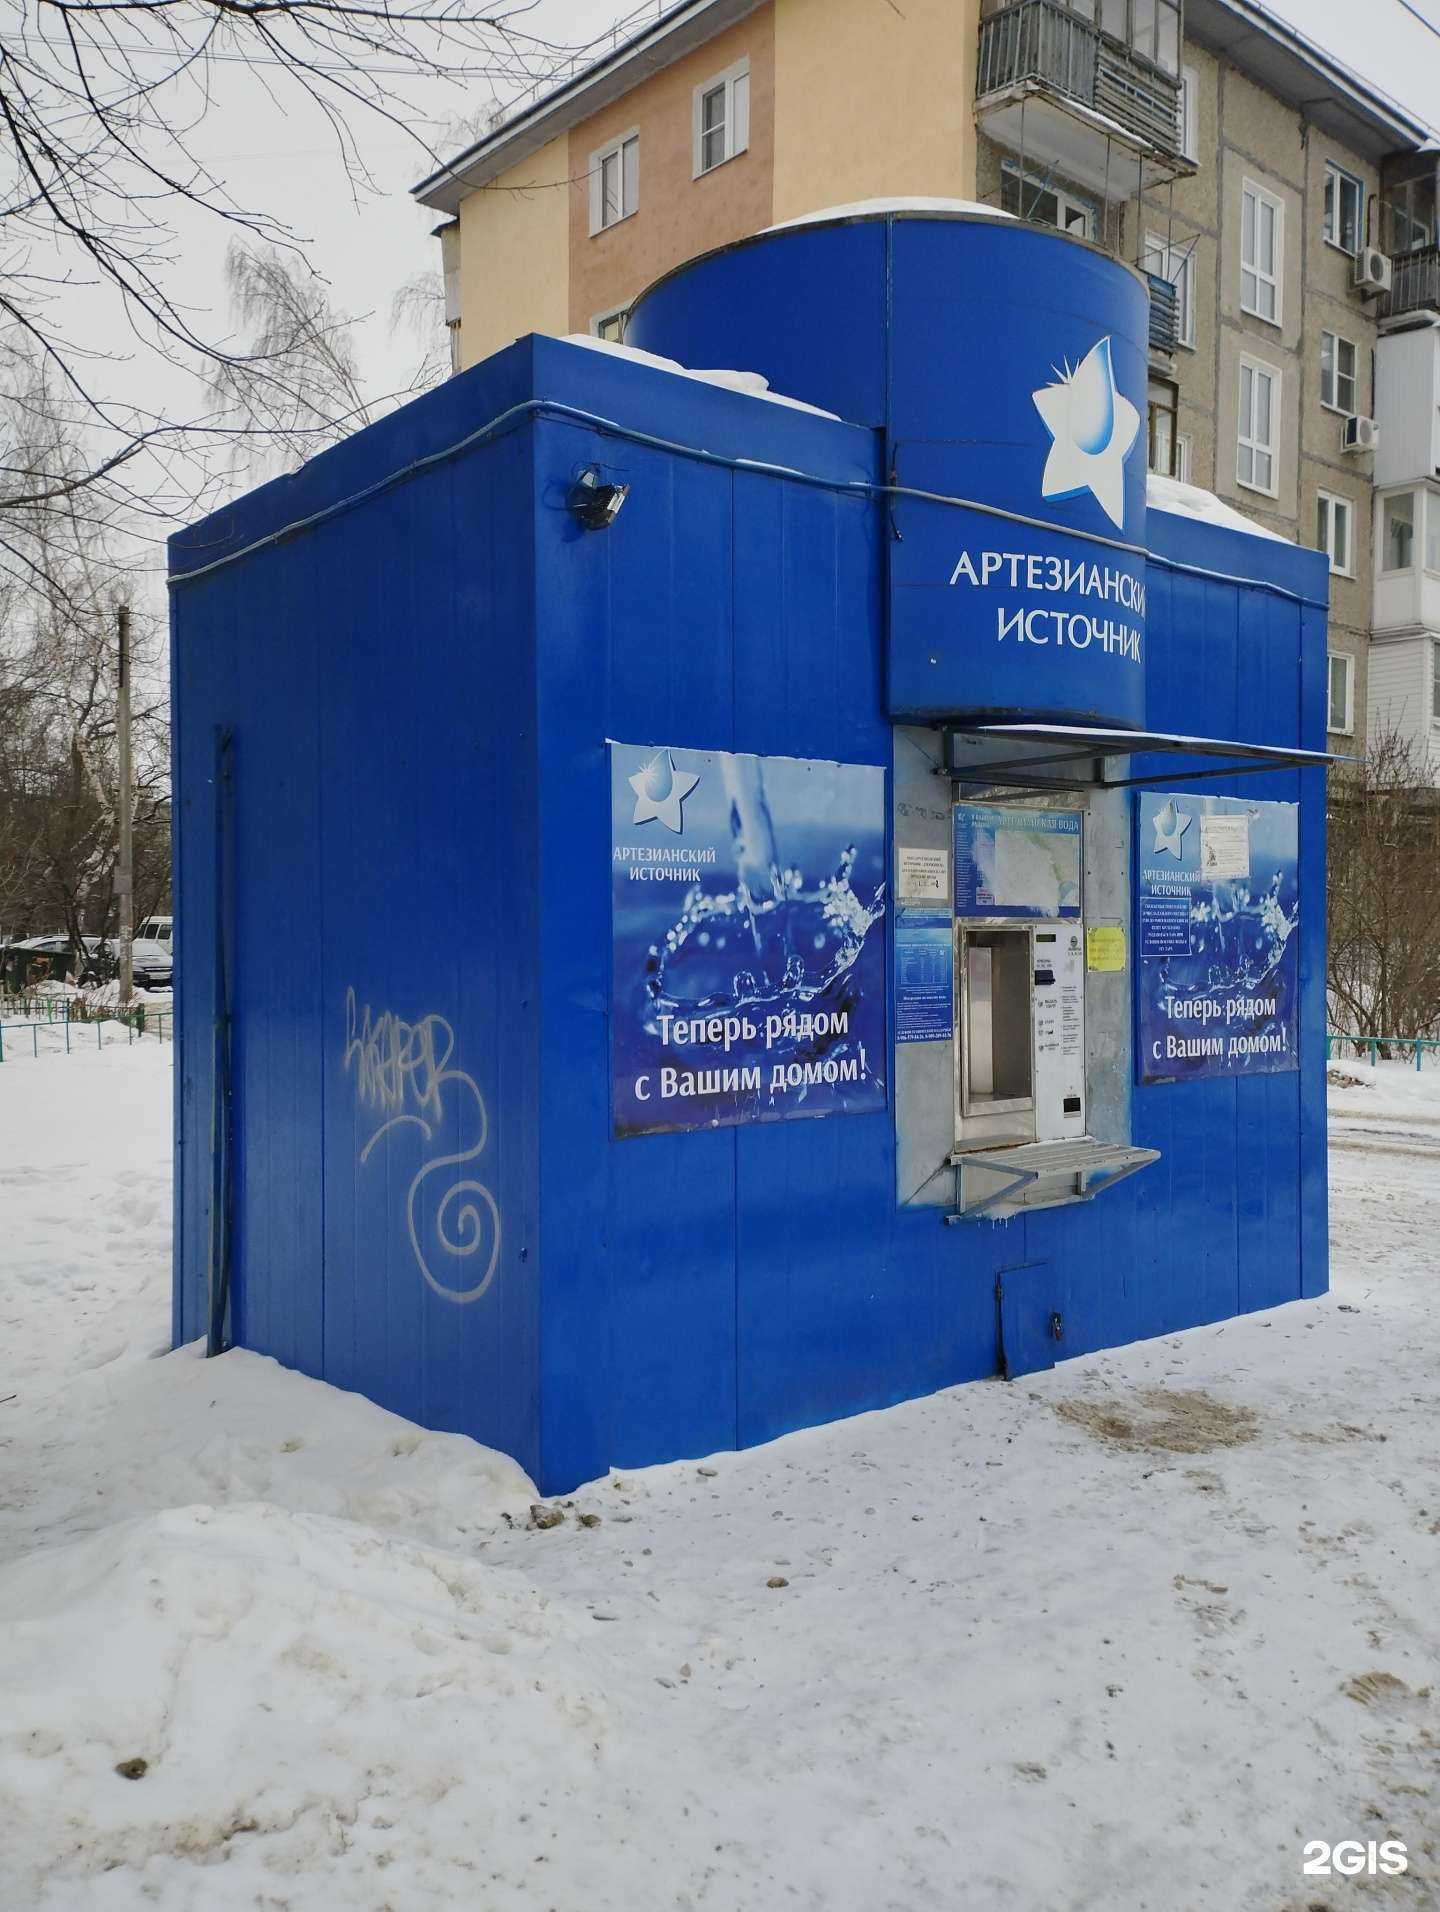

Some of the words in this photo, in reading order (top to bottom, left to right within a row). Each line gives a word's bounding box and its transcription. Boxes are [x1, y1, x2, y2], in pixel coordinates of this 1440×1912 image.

[950, 551, 1145, 621] АРТЕЗИАНСКИ
[997, 607, 1141, 663] ИСТОЧНИК
[613, 846, 717, 864] АРТЕЗИАНСКИЙ
[629, 867, 701, 882] ИСТОЧНИК
[1143, 870, 1201, 883] АРТЕЗИАНСКИЙ
[1151, 884, 1192, 897] ИСТОЧНИК
[1164, 996, 1221, 1025] Теперь
[1226, 998, 1276, 1024] рядом
[656, 1014, 757, 1052] Теперь
[766, 1010, 848, 1049] рядом
[1152, 1040, 1162, 1060] с
[1166, 1035, 1224, 1058] Вашим
[1228, 1026, 1287, 1058] домом!
[635, 1075, 650, 1101] с
[661, 1066, 761, 1098] Вашим
[769, 1047, 867, 1095] домом!
